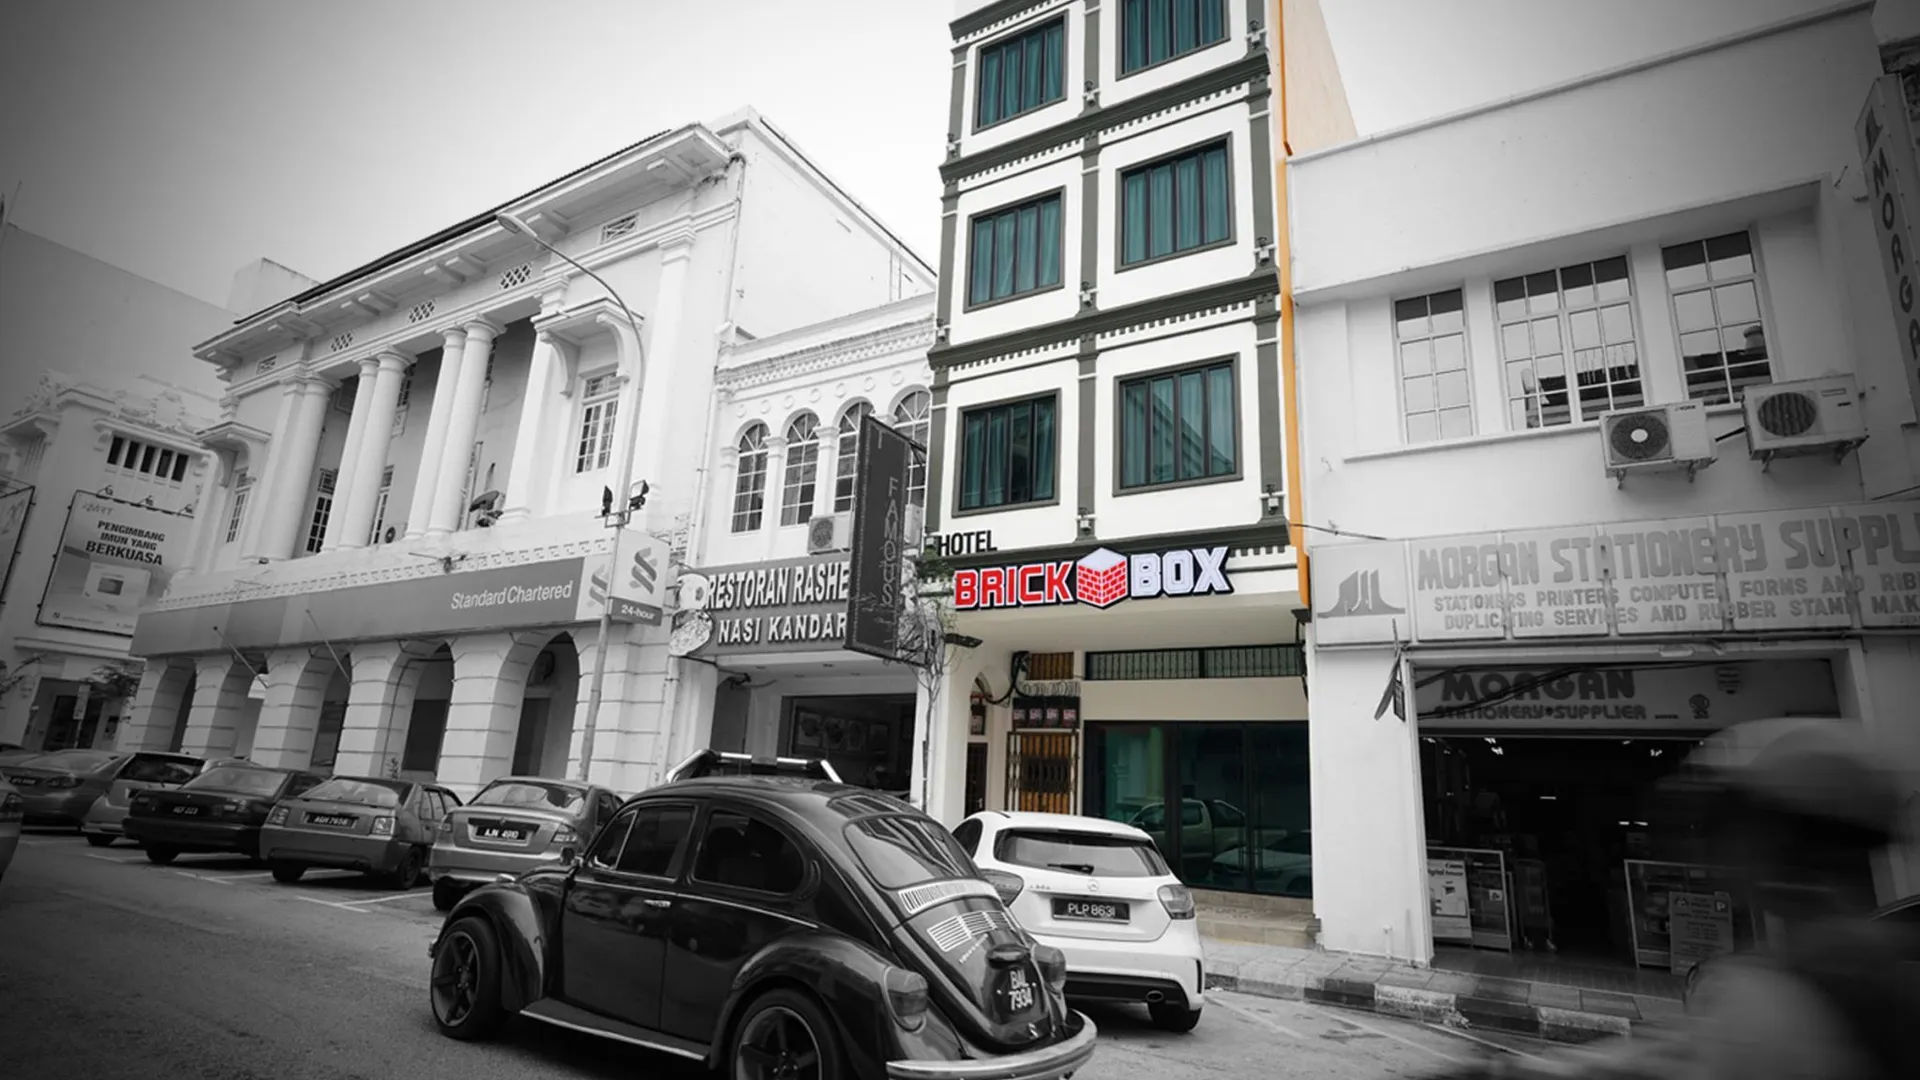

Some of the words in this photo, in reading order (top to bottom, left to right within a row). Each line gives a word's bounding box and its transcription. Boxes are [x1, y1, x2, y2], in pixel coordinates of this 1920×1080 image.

[1872, 146, 1920, 389] MORGA
[97, 520, 165, 542] PENGIMBANG
[100, 532, 128, 545] IMUN
[131, 538, 157, 551] YANG
[882, 477, 899, 606] FAMOUS
[938, 530, 997, 556] HOTEL
[85, 540, 163, 566] BERKUASA
[1418, 540, 1540, 590] MORGAN
[1550, 523, 1768, 583] STATIONERY
[1779, 512, 1920, 570] SUPPL
[705, 566, 791, 609] RESTORAN
[954, 560, 1075, 608] BRICK
[1131, 546, 1234, 597] BOX
[1739, 577, 1808, 598] FORMS
[451, 587, 507, 610] Standard
[507, 580, 574, 605] Chartered
[621, 604, 656, 620] 24-hour
[1651, 603, 1686, 622] AND
[1697, 600, 1777, 621] RUBBER
[718, 617, 761, 643] NASI
[768, 612, 847, 641] KANDAR
[1442, 670, 1635, 701] MORGAN
[1067, 902, 1090, 916] PLP
[1090, 904, 1116, 918] 8631
